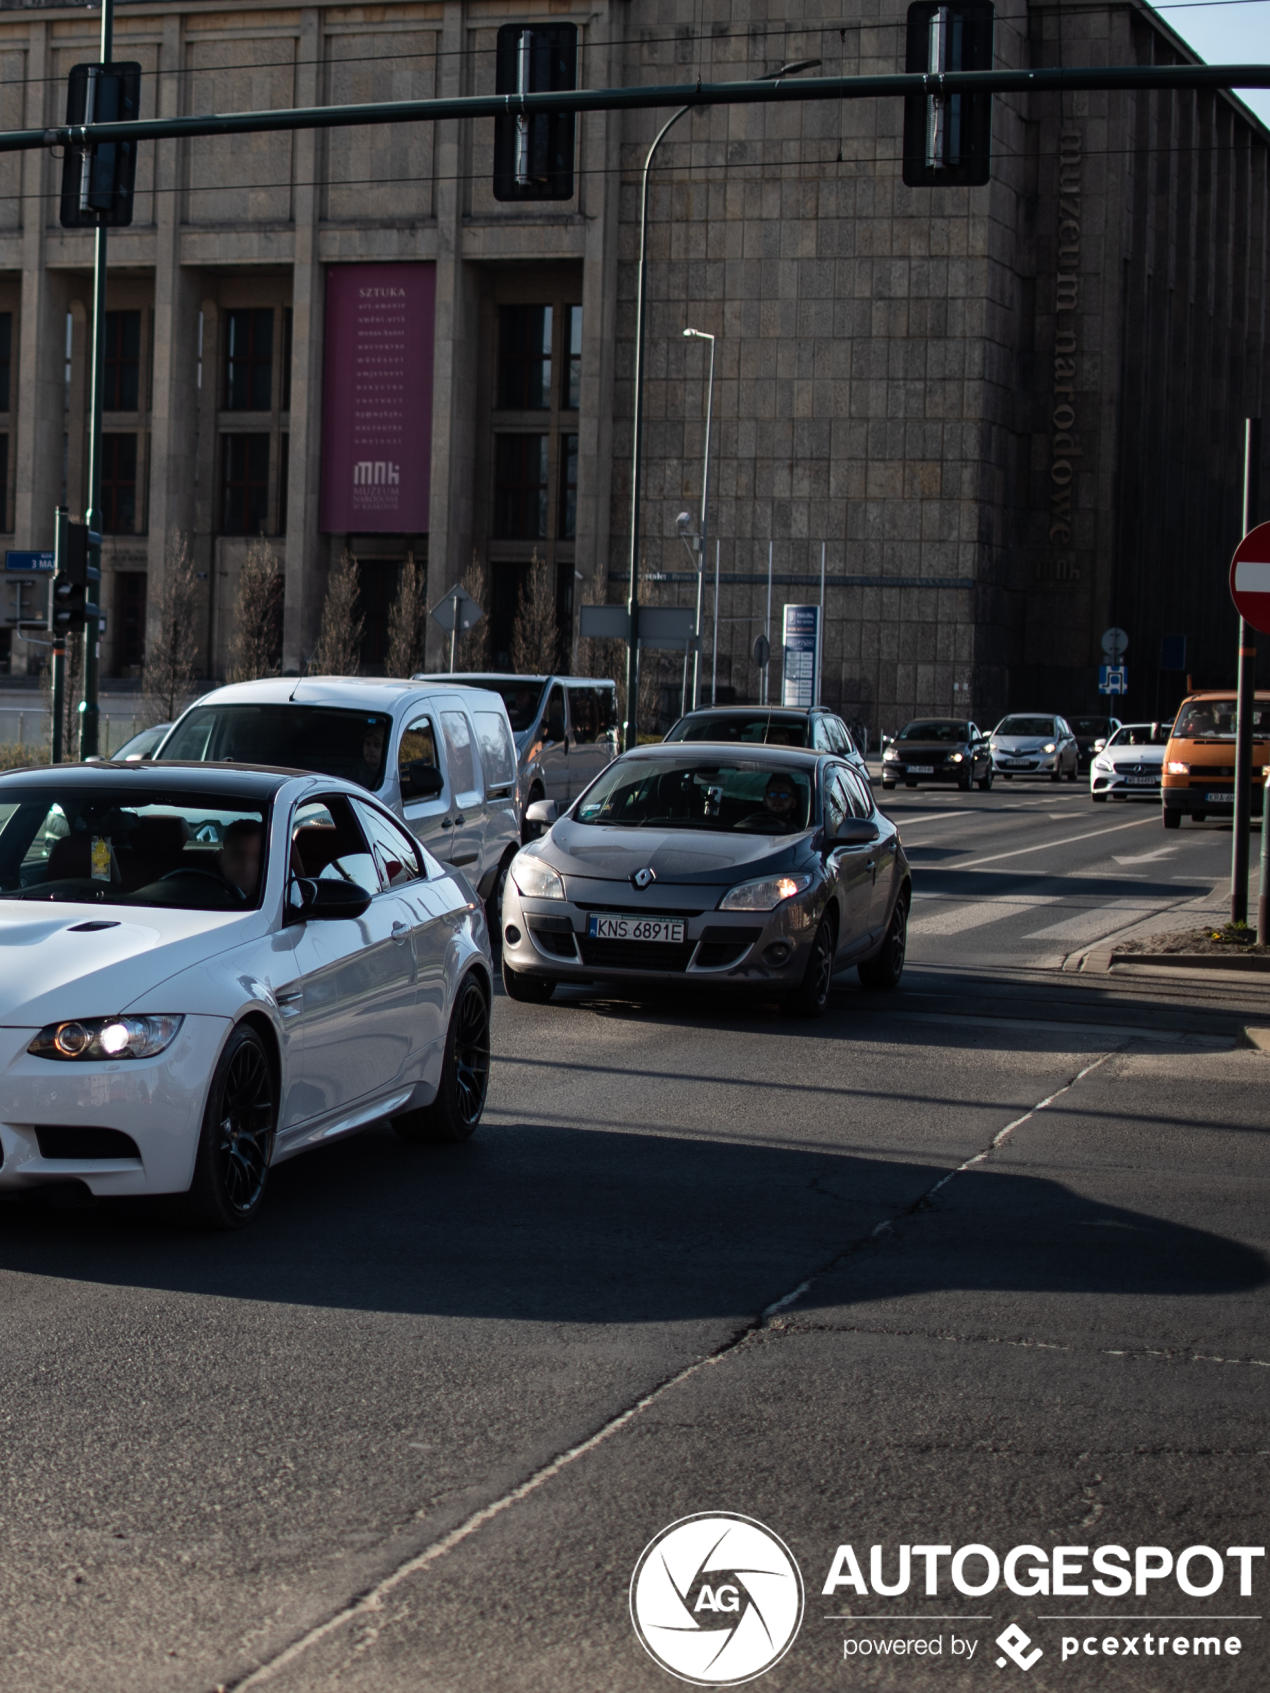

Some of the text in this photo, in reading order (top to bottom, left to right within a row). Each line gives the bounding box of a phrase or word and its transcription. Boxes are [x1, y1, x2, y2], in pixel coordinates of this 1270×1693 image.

[359, 287, 406, 298] SZTUKA
[1049, 129, 1084, 546] muzeum narodowe
[31, 559, 37, 569] 3
[598, 920, 682, 941] KNS 6891E
